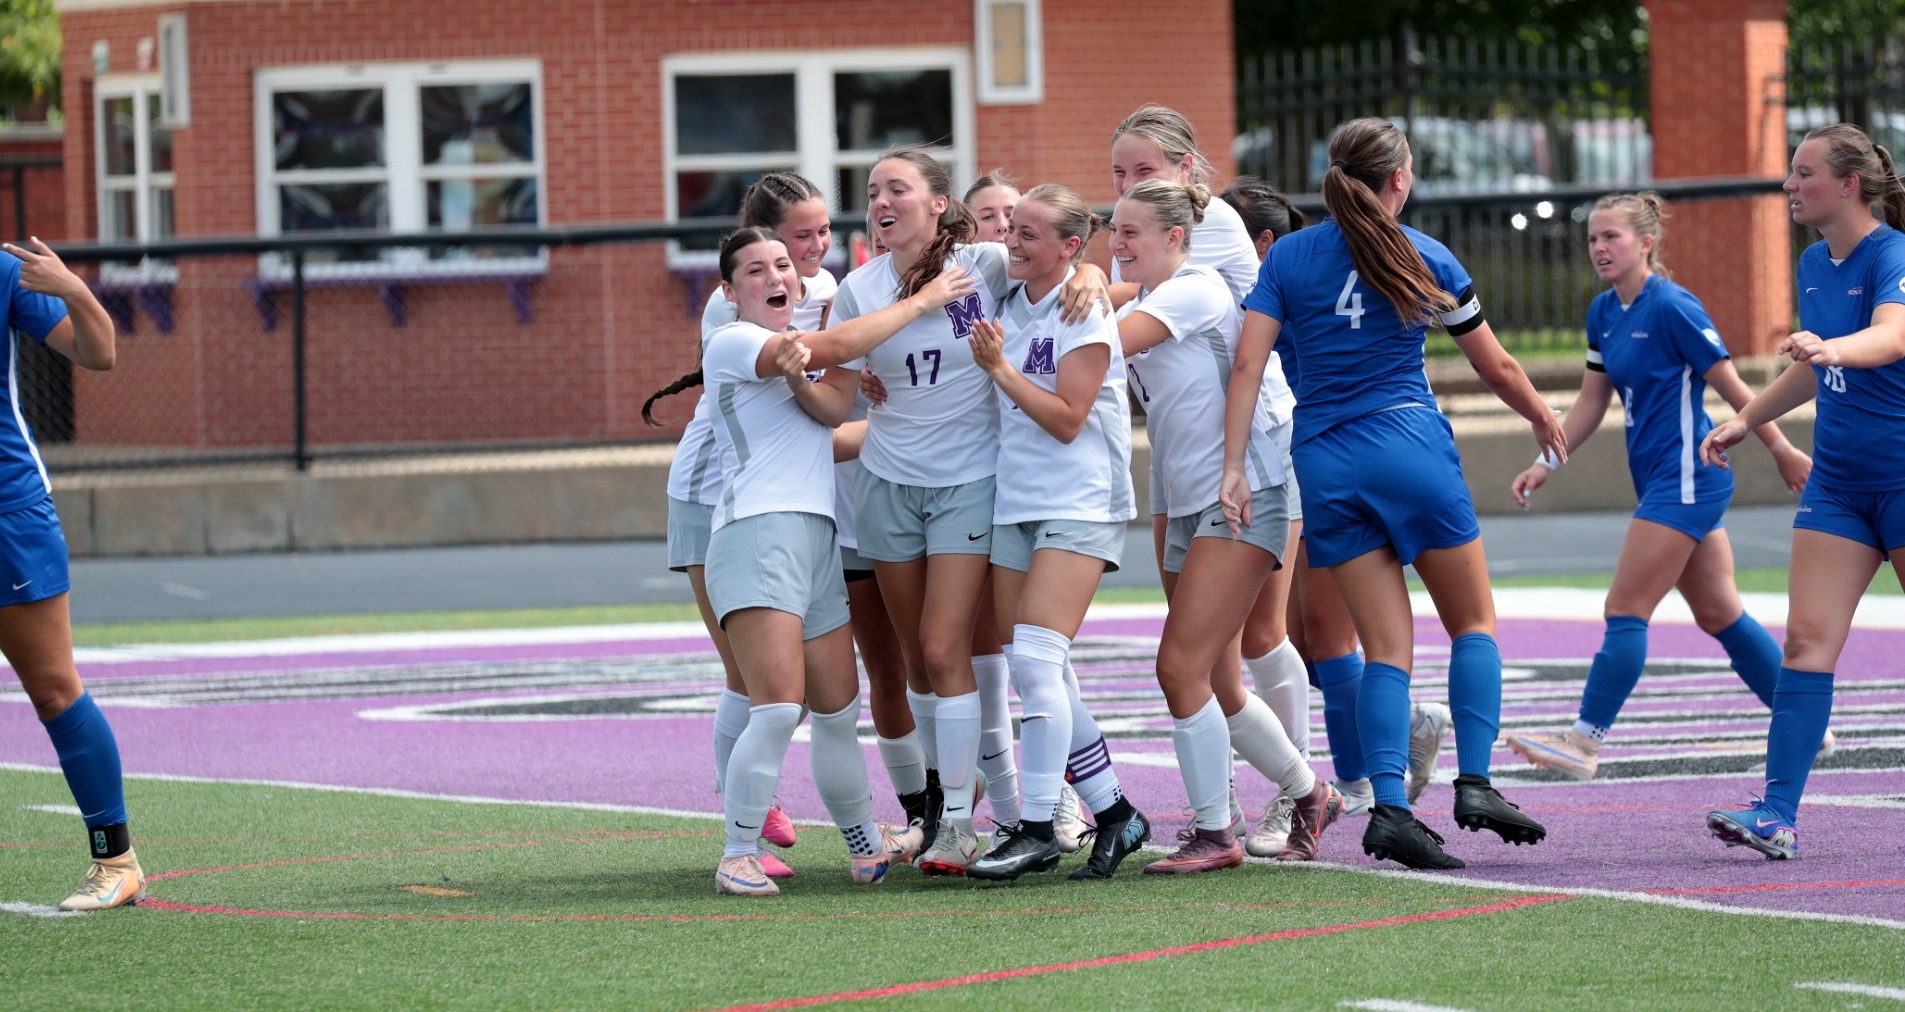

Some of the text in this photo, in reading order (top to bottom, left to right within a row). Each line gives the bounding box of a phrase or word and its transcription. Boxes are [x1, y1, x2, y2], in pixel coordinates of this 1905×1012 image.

[944, 291, 985, 340] M
[1335, 269, 1365, 330] 4
[905, 349, 941, 387] 17
[1022, 338, 1056, 375] M
